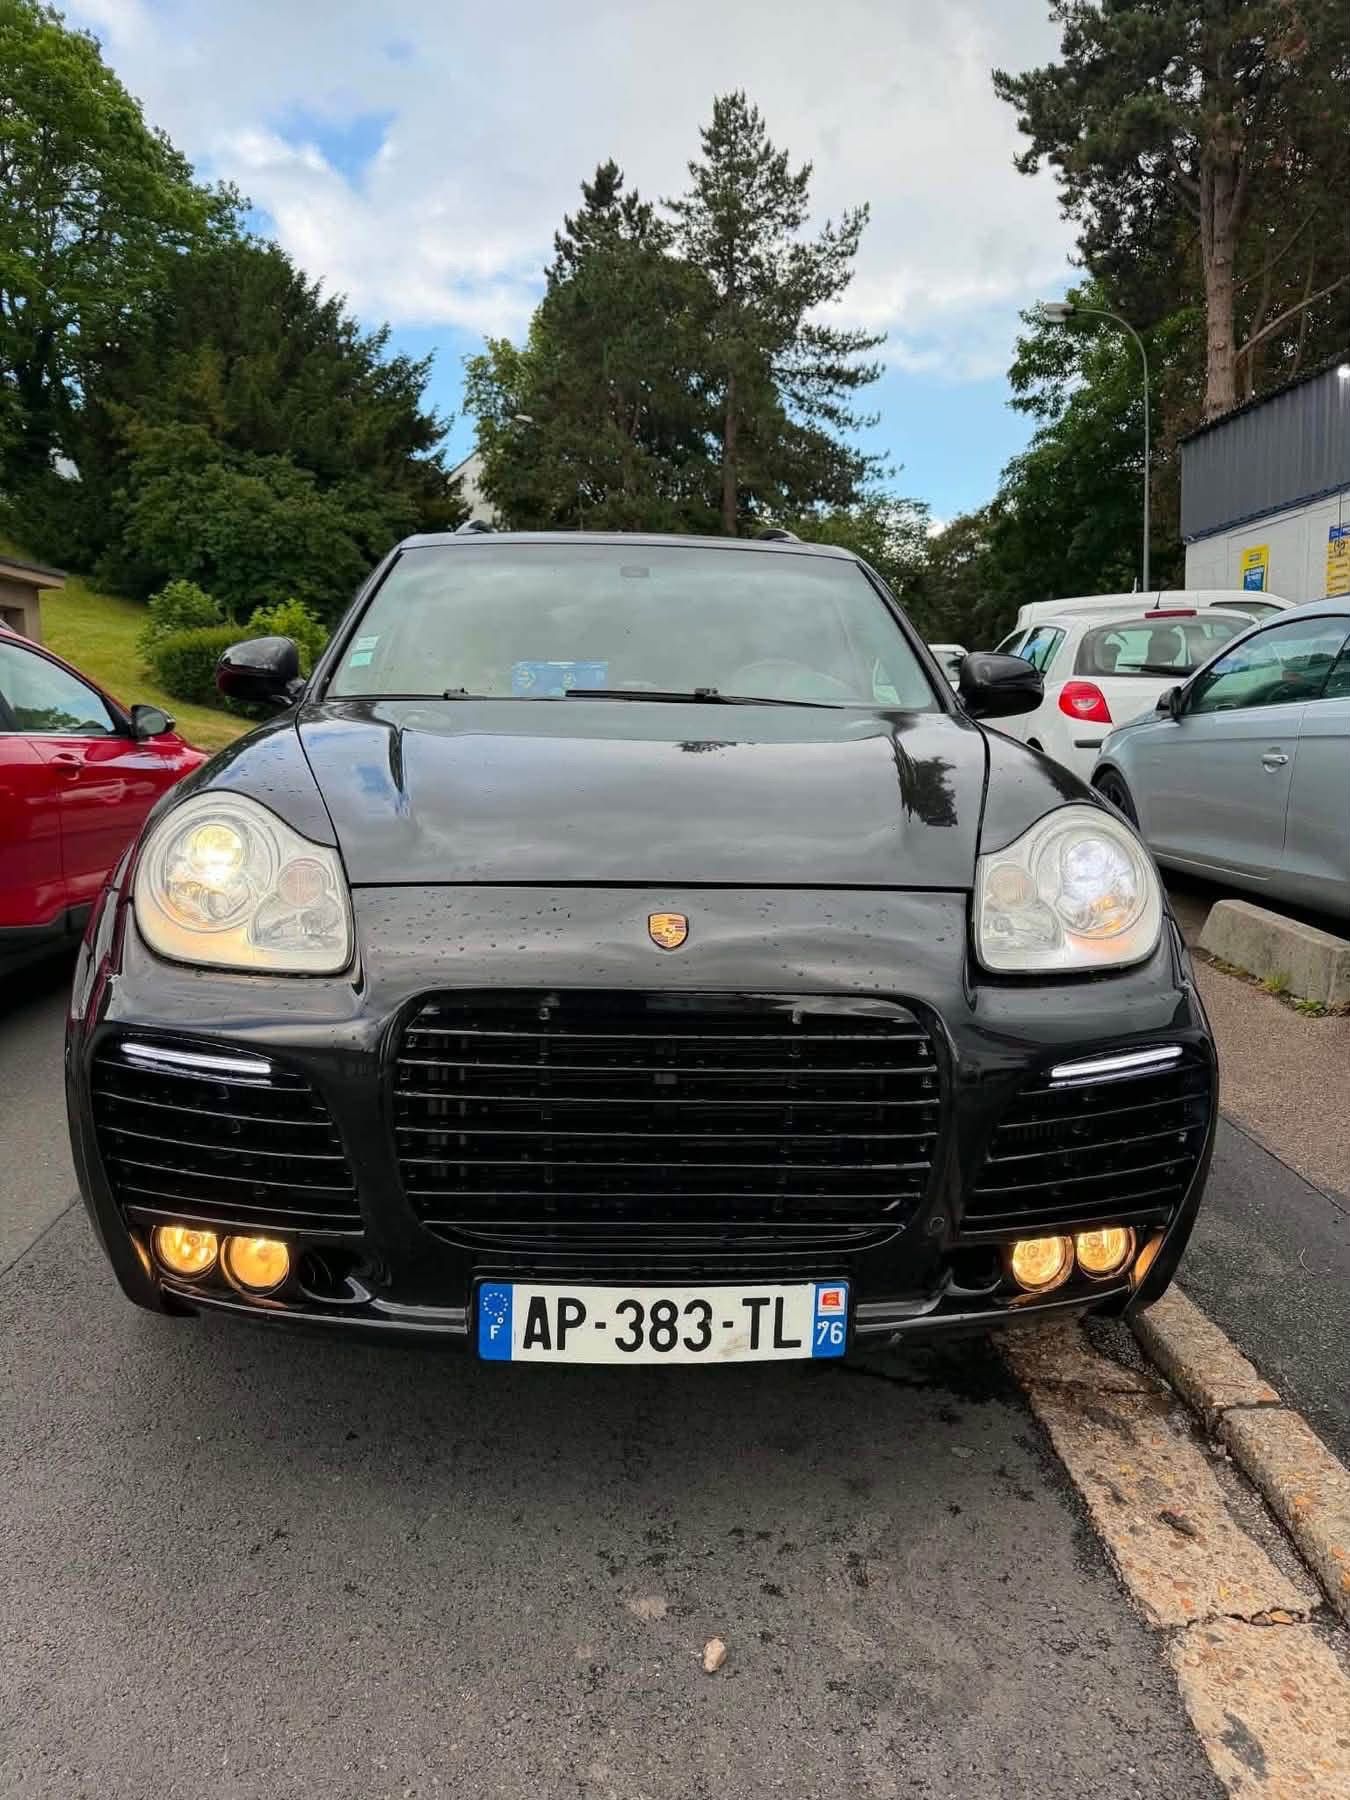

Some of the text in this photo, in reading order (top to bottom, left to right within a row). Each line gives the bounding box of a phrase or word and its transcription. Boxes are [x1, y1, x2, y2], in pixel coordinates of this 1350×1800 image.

[489, 1325, 500, 1340] F
[523, 1296, 802, 1353] AP-383-TL
[816, 1321, 844, 1345] 76
